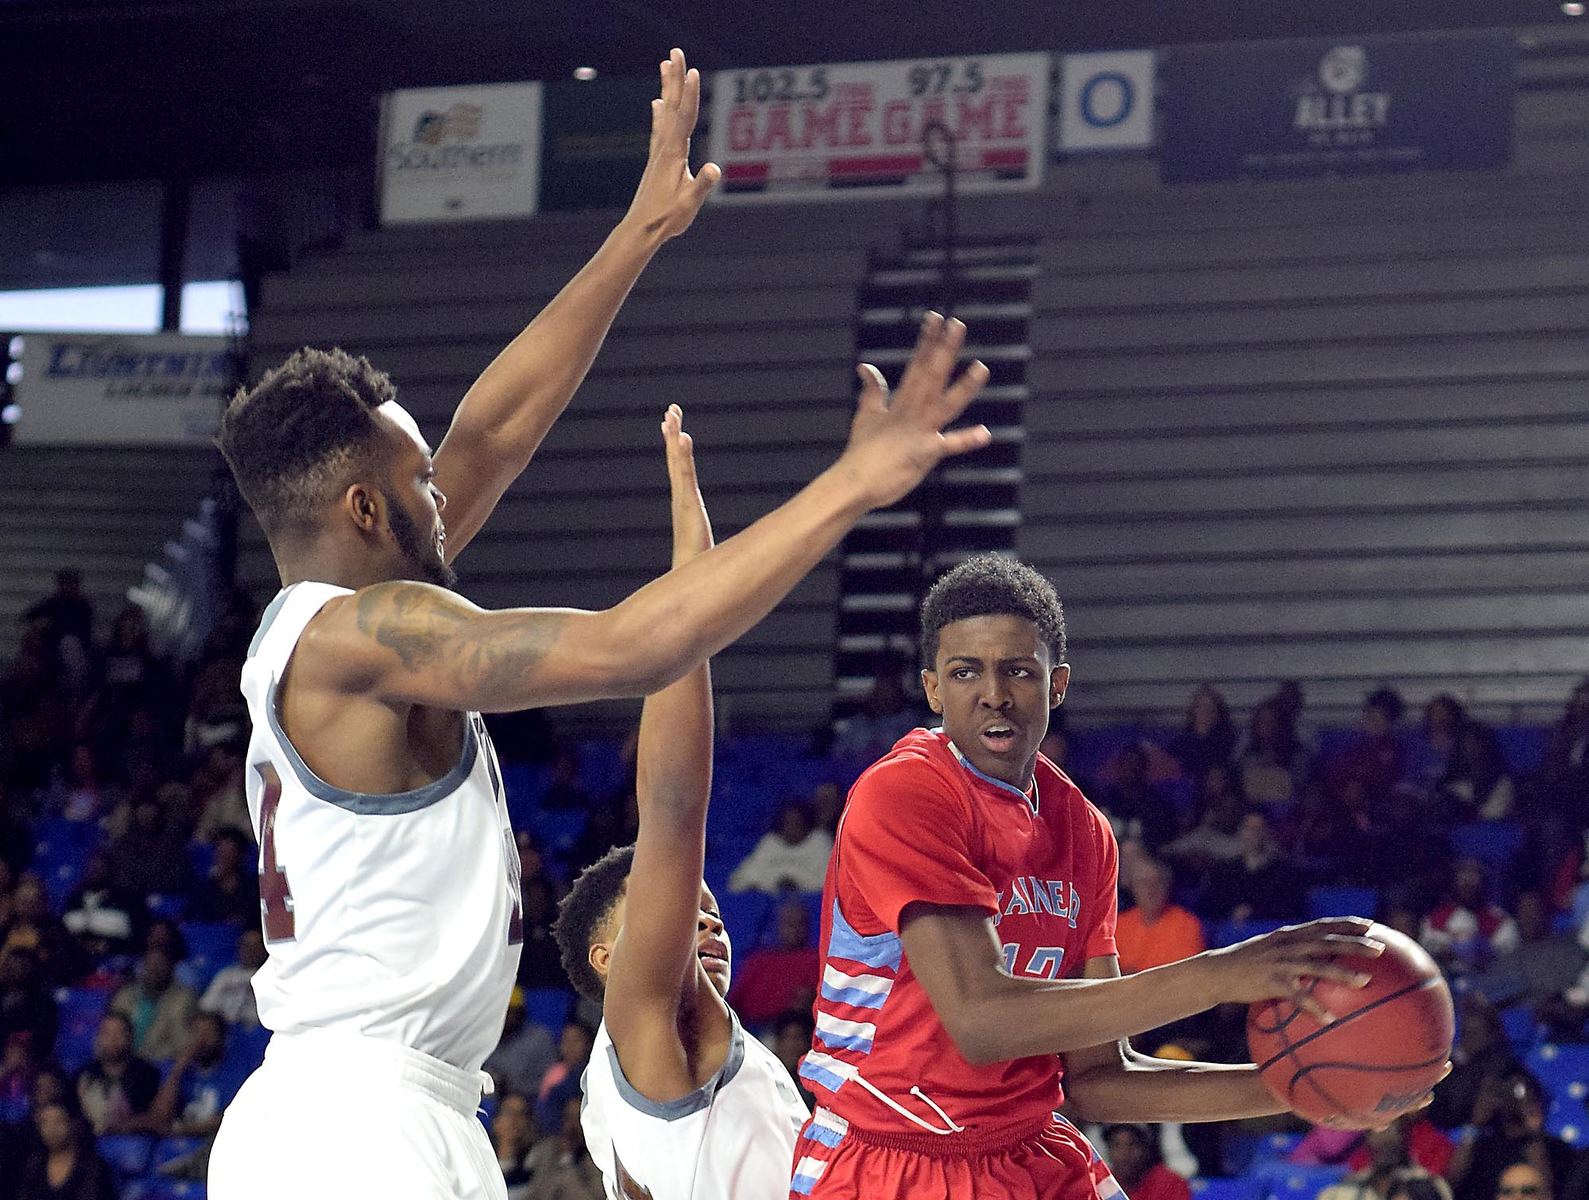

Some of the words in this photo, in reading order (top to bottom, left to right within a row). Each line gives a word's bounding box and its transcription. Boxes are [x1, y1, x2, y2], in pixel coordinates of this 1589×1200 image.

[734, 67, 829, 102] 102.5
[908, 61, 984, 96] 97.5
[728, 102, 872, 151] GAME
[884, 93, 1028, 145] GAME
